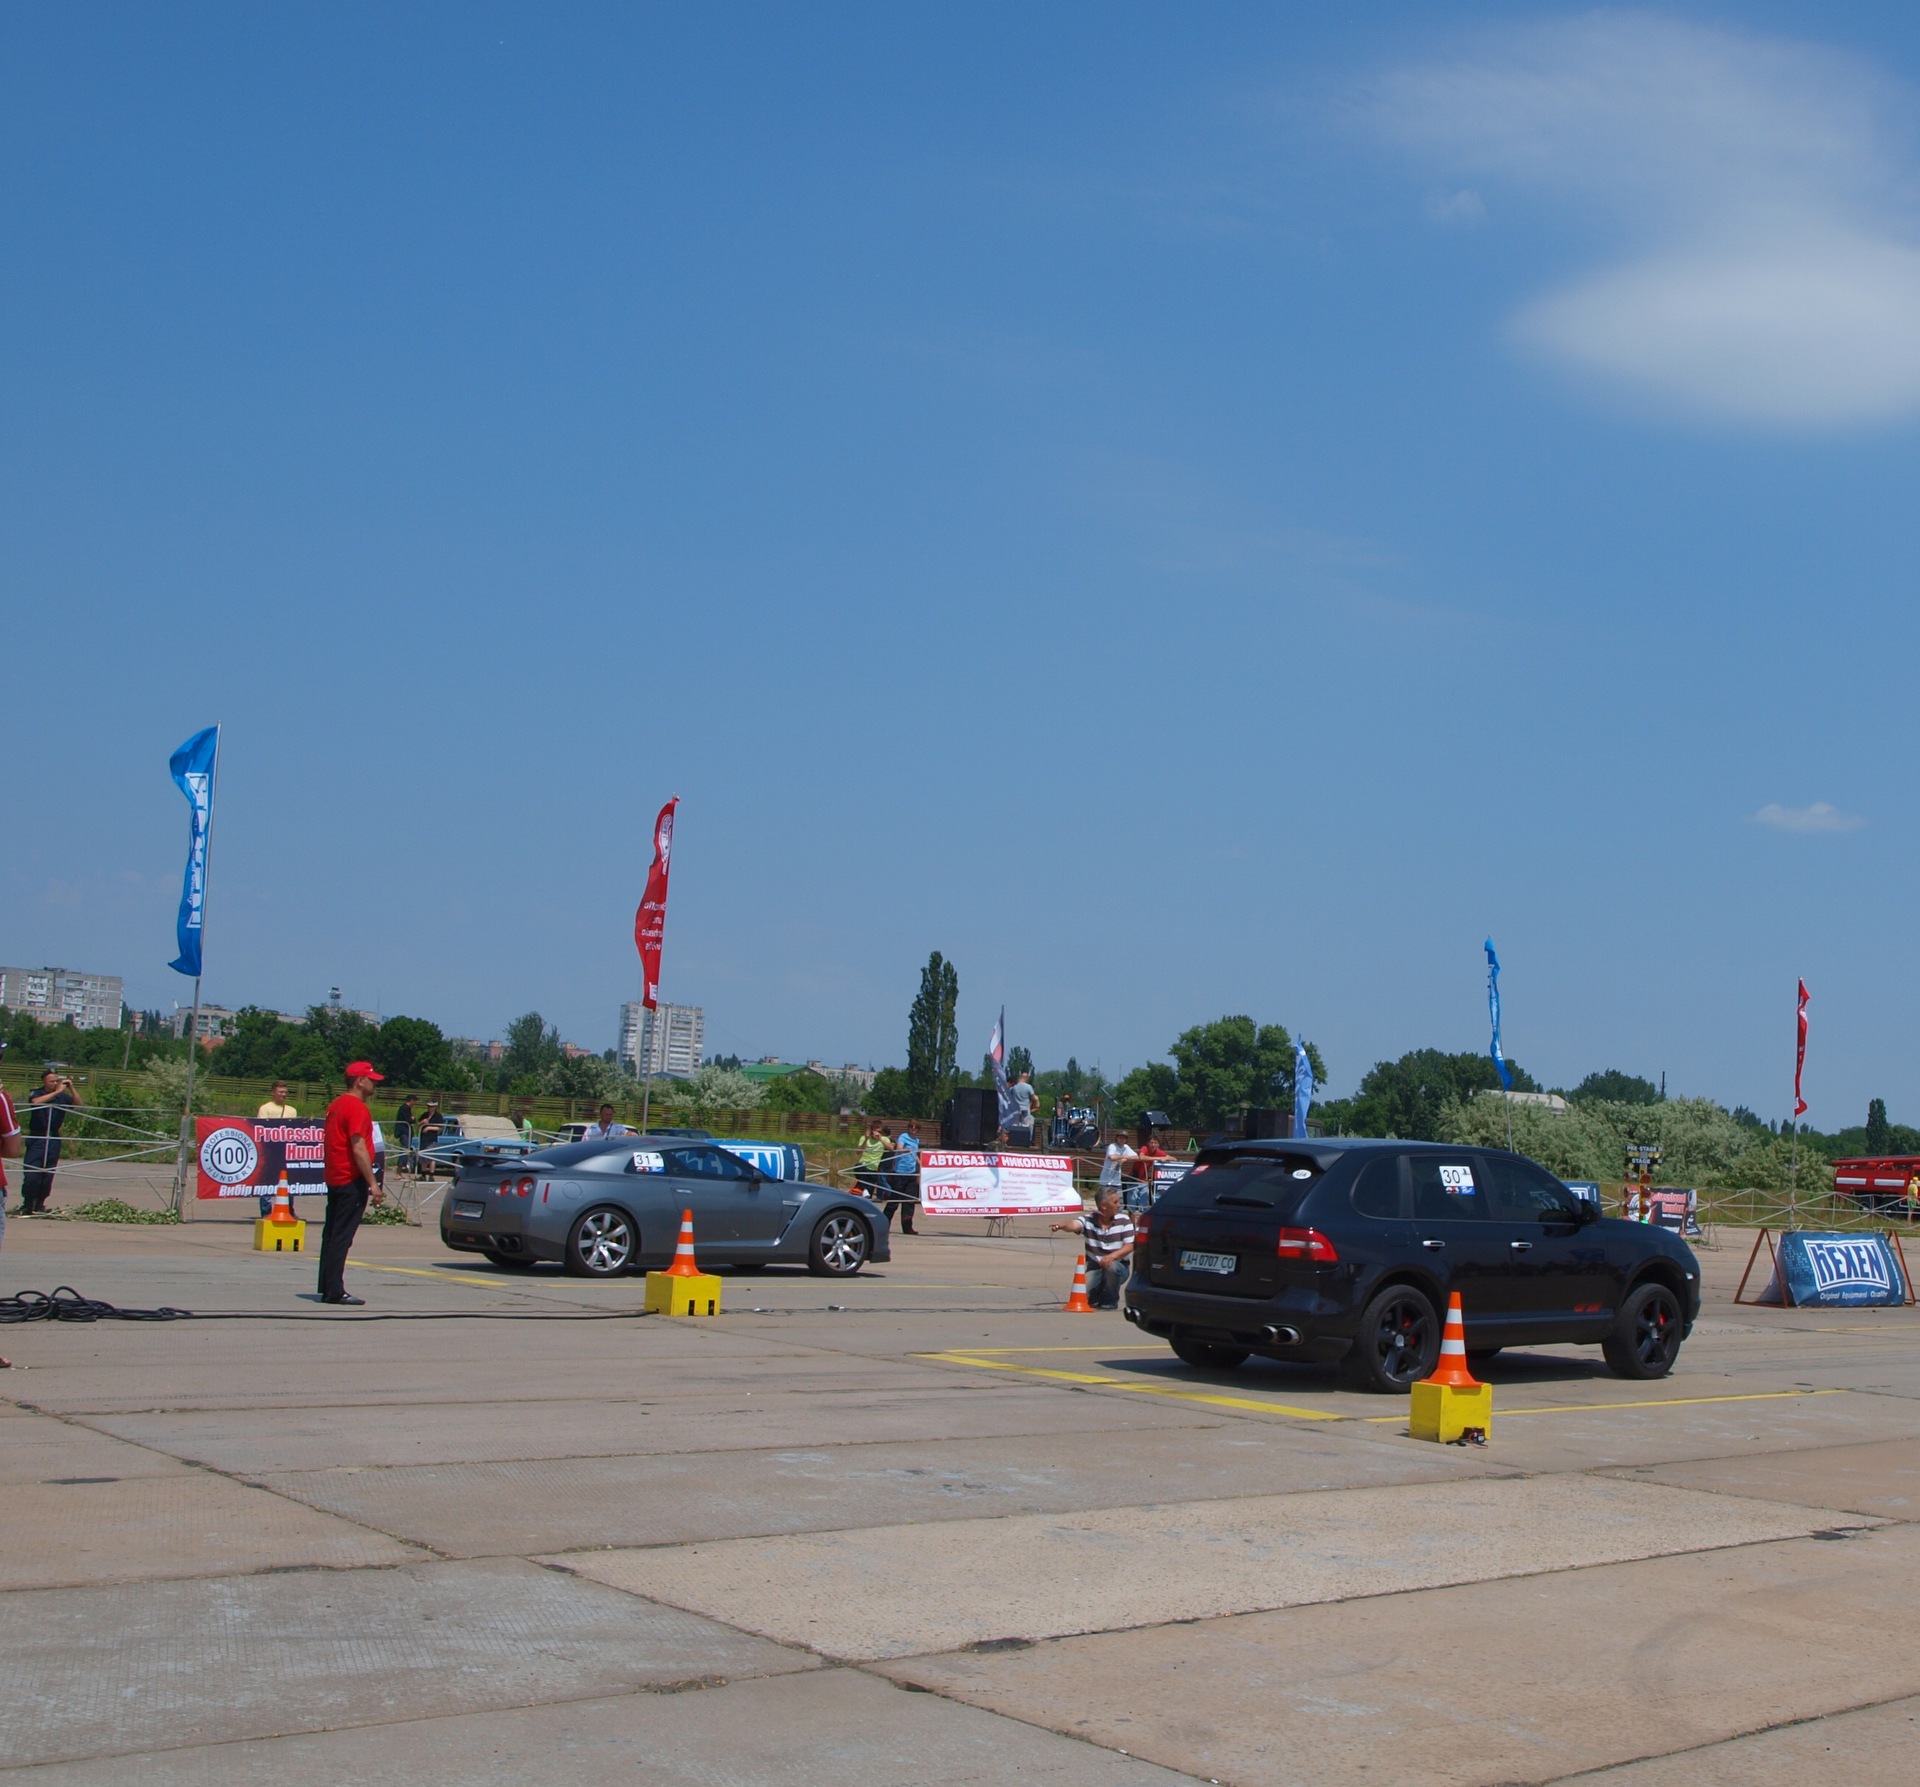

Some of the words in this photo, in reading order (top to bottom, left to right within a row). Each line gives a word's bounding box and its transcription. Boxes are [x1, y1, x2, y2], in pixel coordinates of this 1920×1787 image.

[215, 1147, 244, 1165] 100
[636, 1154, 650, 1165] 31
[928, 1155, 999, 1167] АВТОБАЗАР
[1001, 1157, 1068, 1170] НИКОЛАЕВА
[206, 1165, 252, 1182] HUNDERT
[1442, 1169, 1461, 1184] 30
[1186, 1253, 1199, 1266] AH
[1199, 1255, 1218, 1267] 0707
[1221, 1257, 1235, 1269] CO
